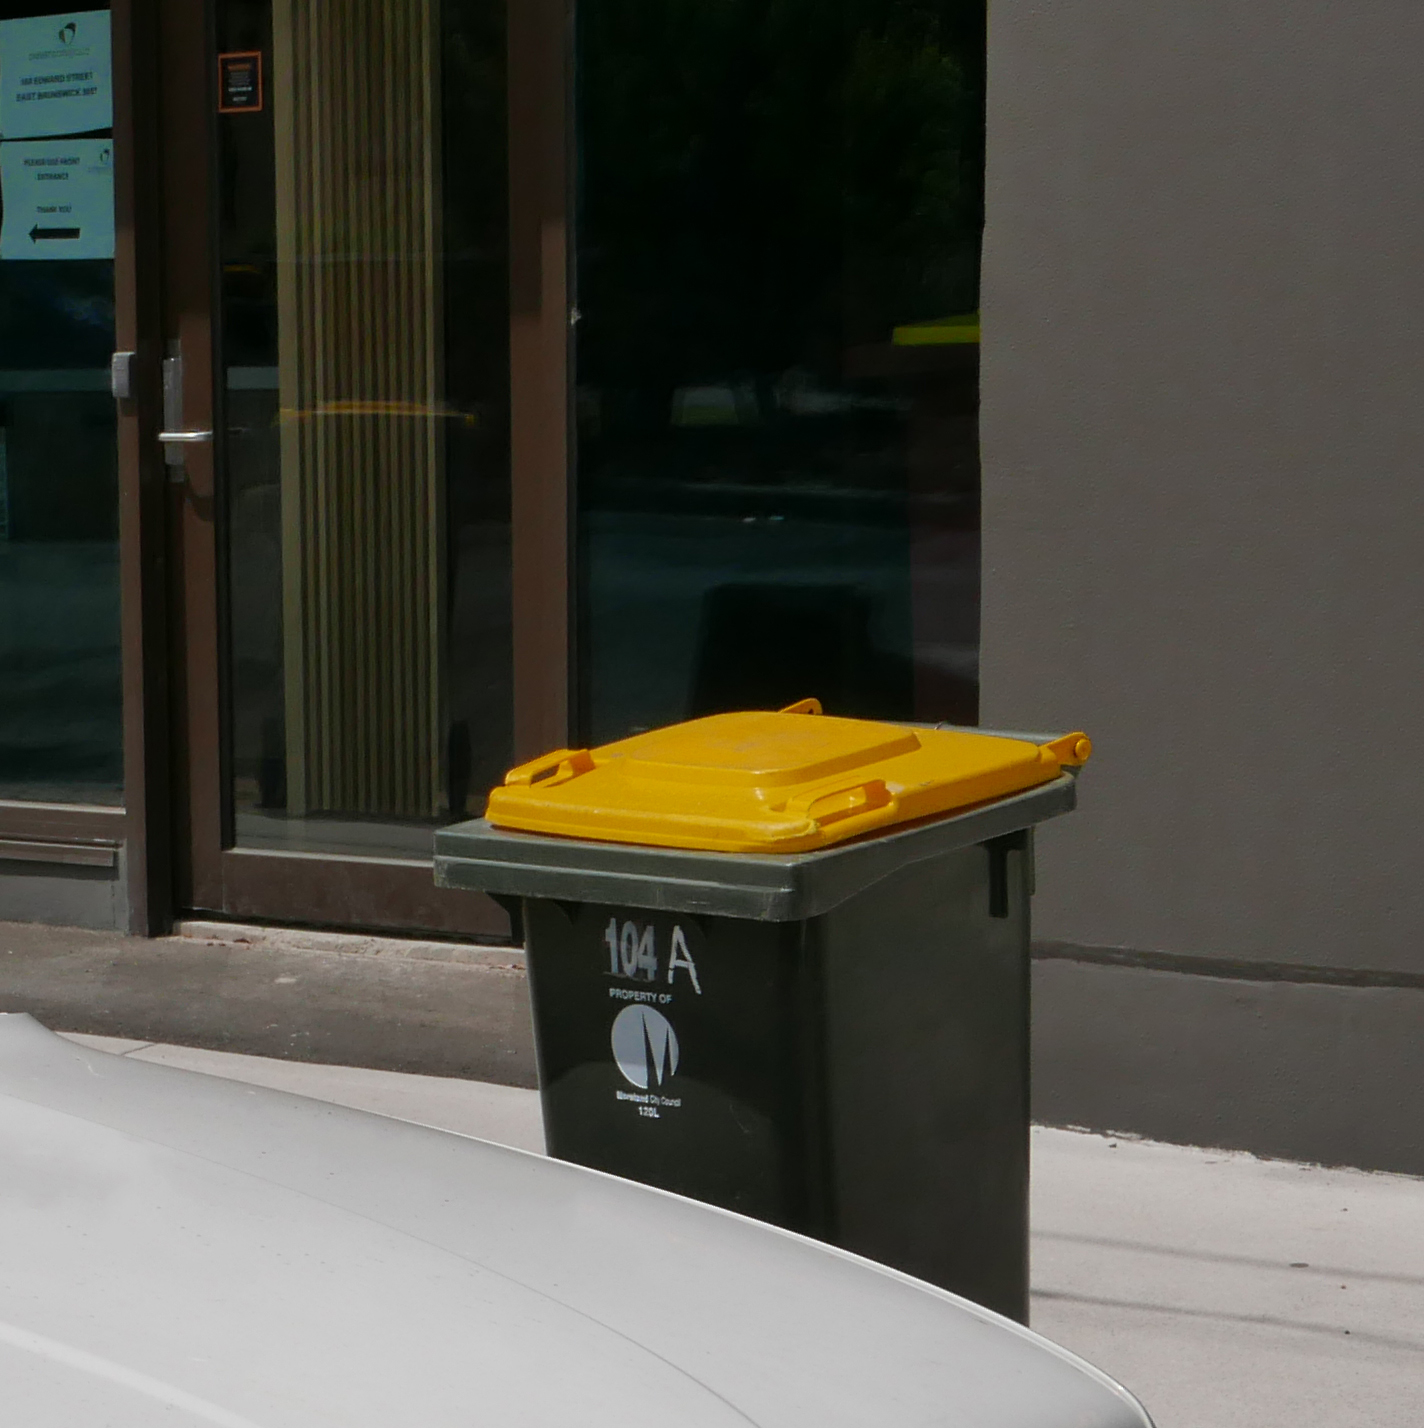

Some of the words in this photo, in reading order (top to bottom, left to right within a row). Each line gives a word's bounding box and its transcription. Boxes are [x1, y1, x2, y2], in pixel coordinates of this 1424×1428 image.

[66, 71, 93, 83] STREET
[37, 89, 81, 101] BRUNSWICK
[605, 917, 658, 981] 104
[667, 925, 702, 995] A
[609, 988, 657, 1003] PROPERTY
[658, 993, 672, 1004] OF
[638, 1106, 660, 1118] 120L
